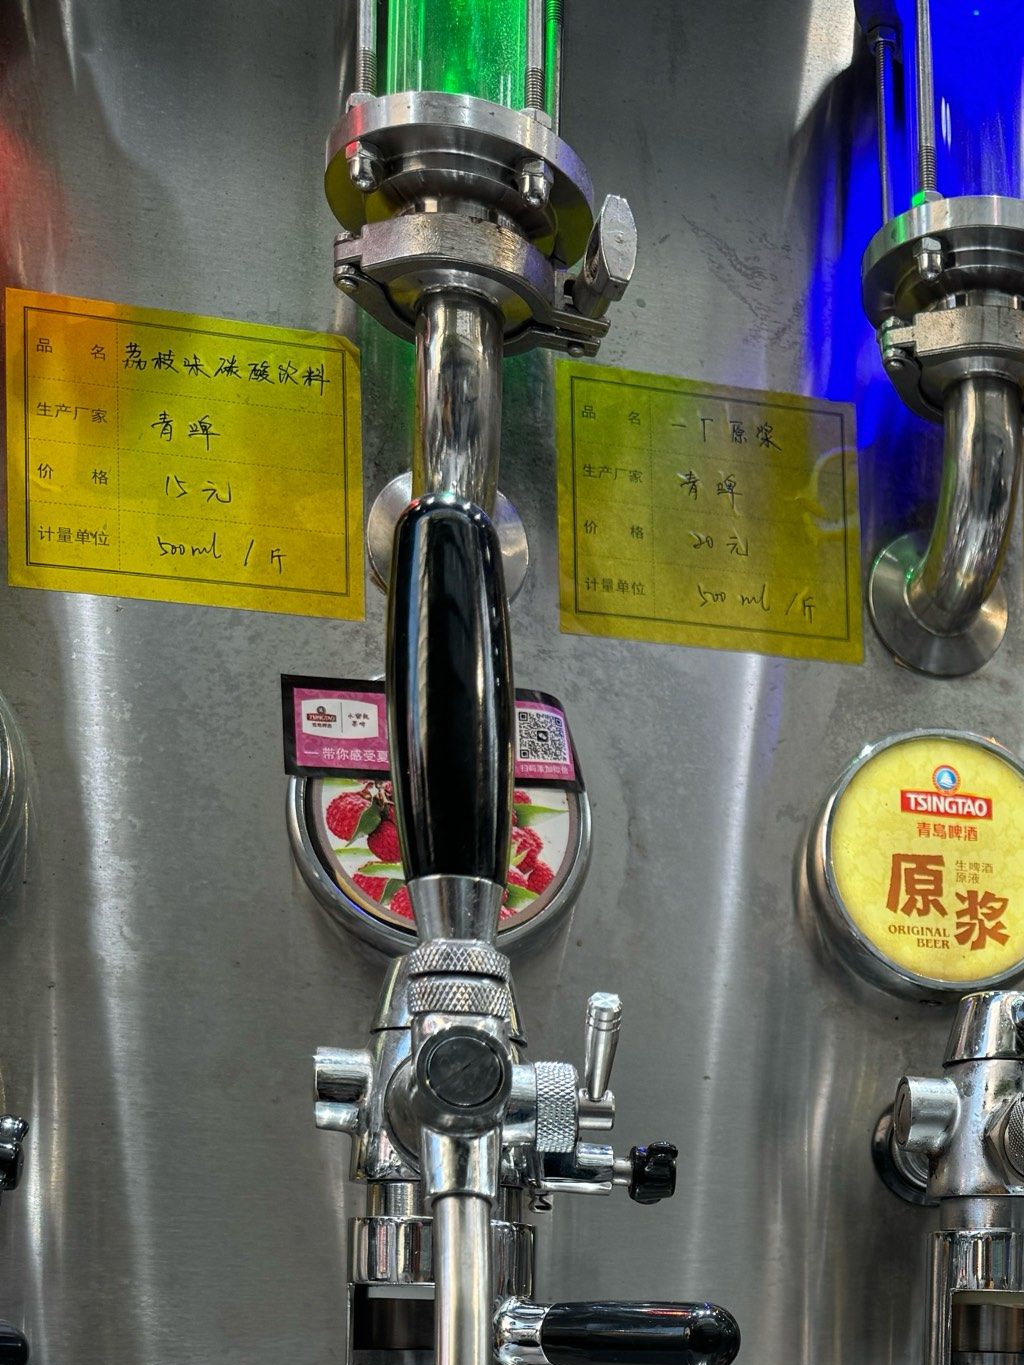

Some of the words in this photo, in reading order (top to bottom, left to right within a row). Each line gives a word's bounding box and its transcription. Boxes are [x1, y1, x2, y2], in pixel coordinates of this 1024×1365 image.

[36, 402, 108, 424] 生产厂家
[151, 412, 221, 450] 青啤
[583, 464, 643, 484] 生产厂家
[38, 526, 110, 547] 计量单位
[584, 577, 646, 597] 计量单位
[906, 793, 988, 816] TSINGTAO
[916, 822, 978, 842] 青岛啤酒
[888, 924, 950, 938] ORIGINAL
[916, 938, 950, 950] BEER
